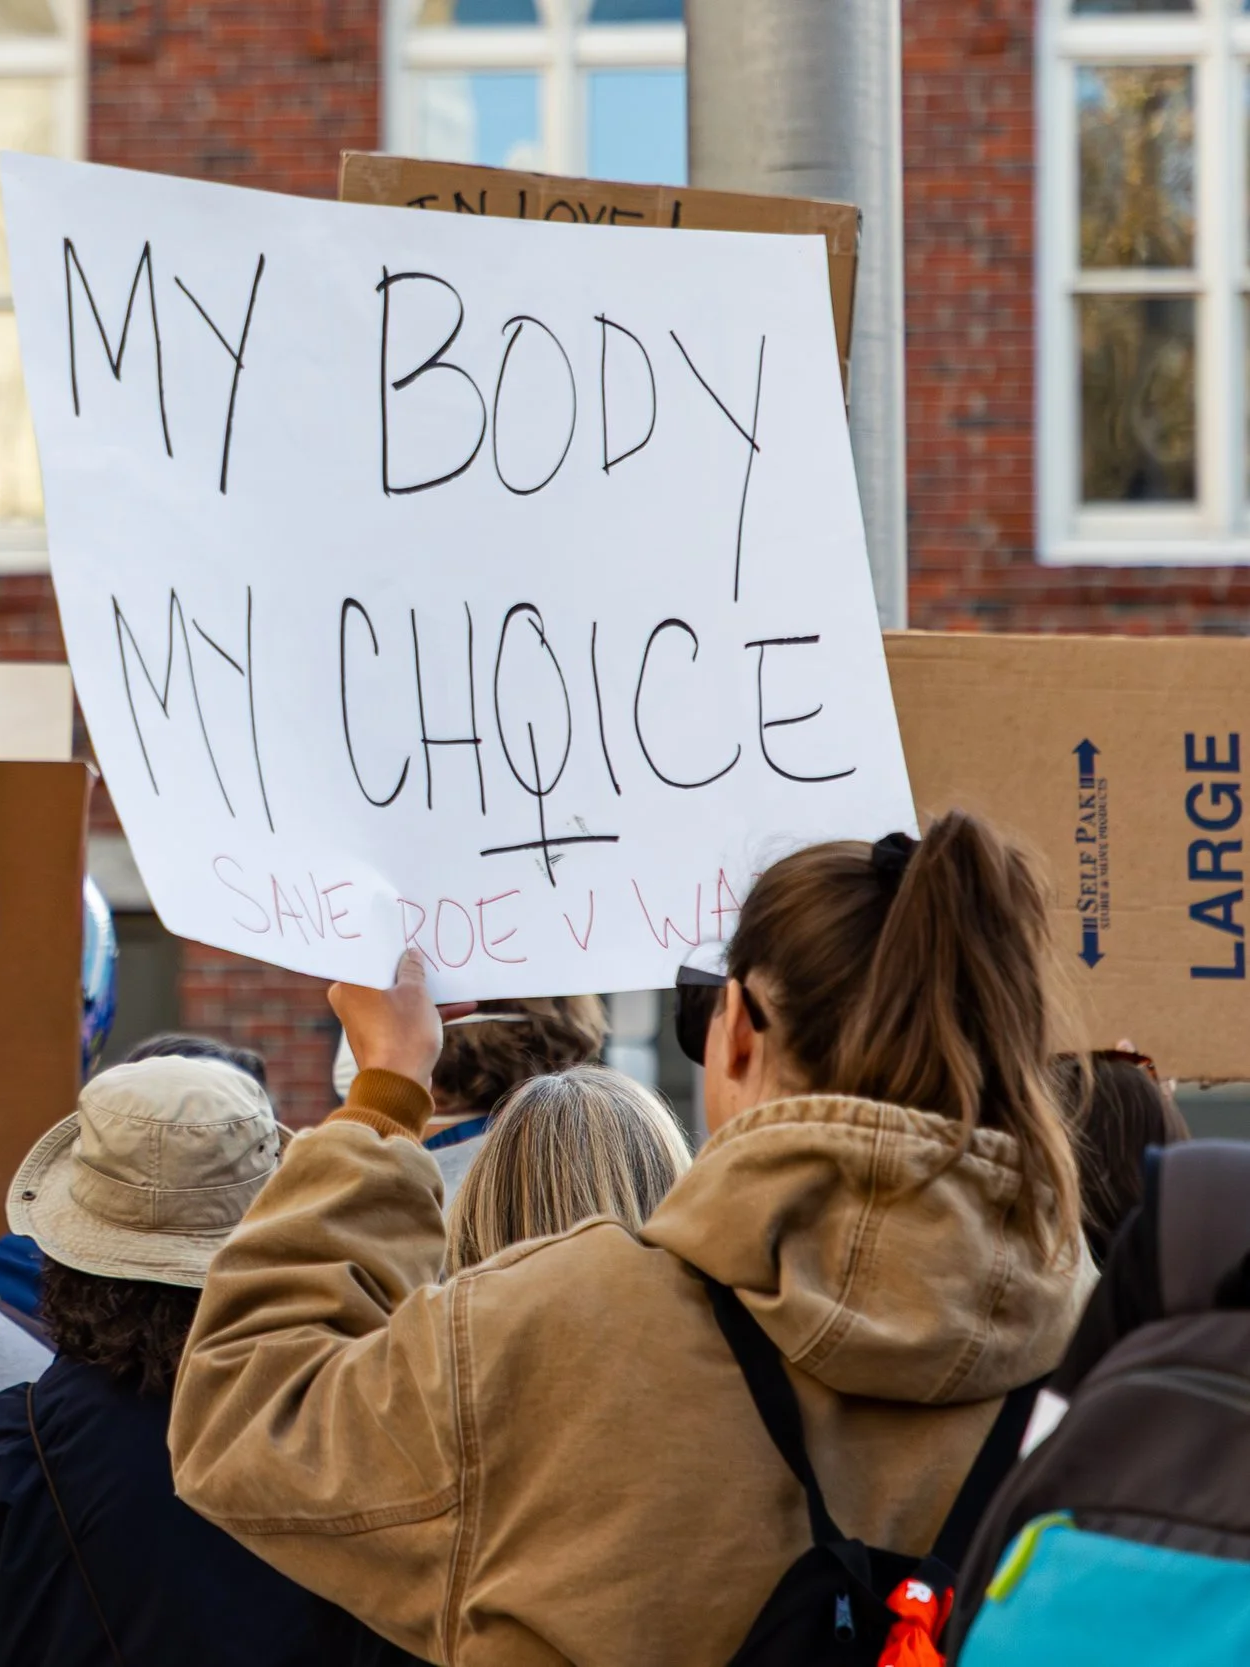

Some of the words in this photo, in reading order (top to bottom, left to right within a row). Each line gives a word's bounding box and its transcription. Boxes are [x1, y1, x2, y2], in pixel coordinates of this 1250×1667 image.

[63, 236, 266, 494] MY
[375, 265, 767, 602] BODY
[111, 585, 275, 833] MY
[340, 597, 857, 815] CHOICE
[1075, 793, 1097, 845] PAK
[1076, 852, 1099, 914] SELF
[1184, 732, 1246, 980] LARGE
[213, 856, 362, 946] SAVE
[397, 889, 528, 972] ROE
[631, 867, 764, 949] WA
